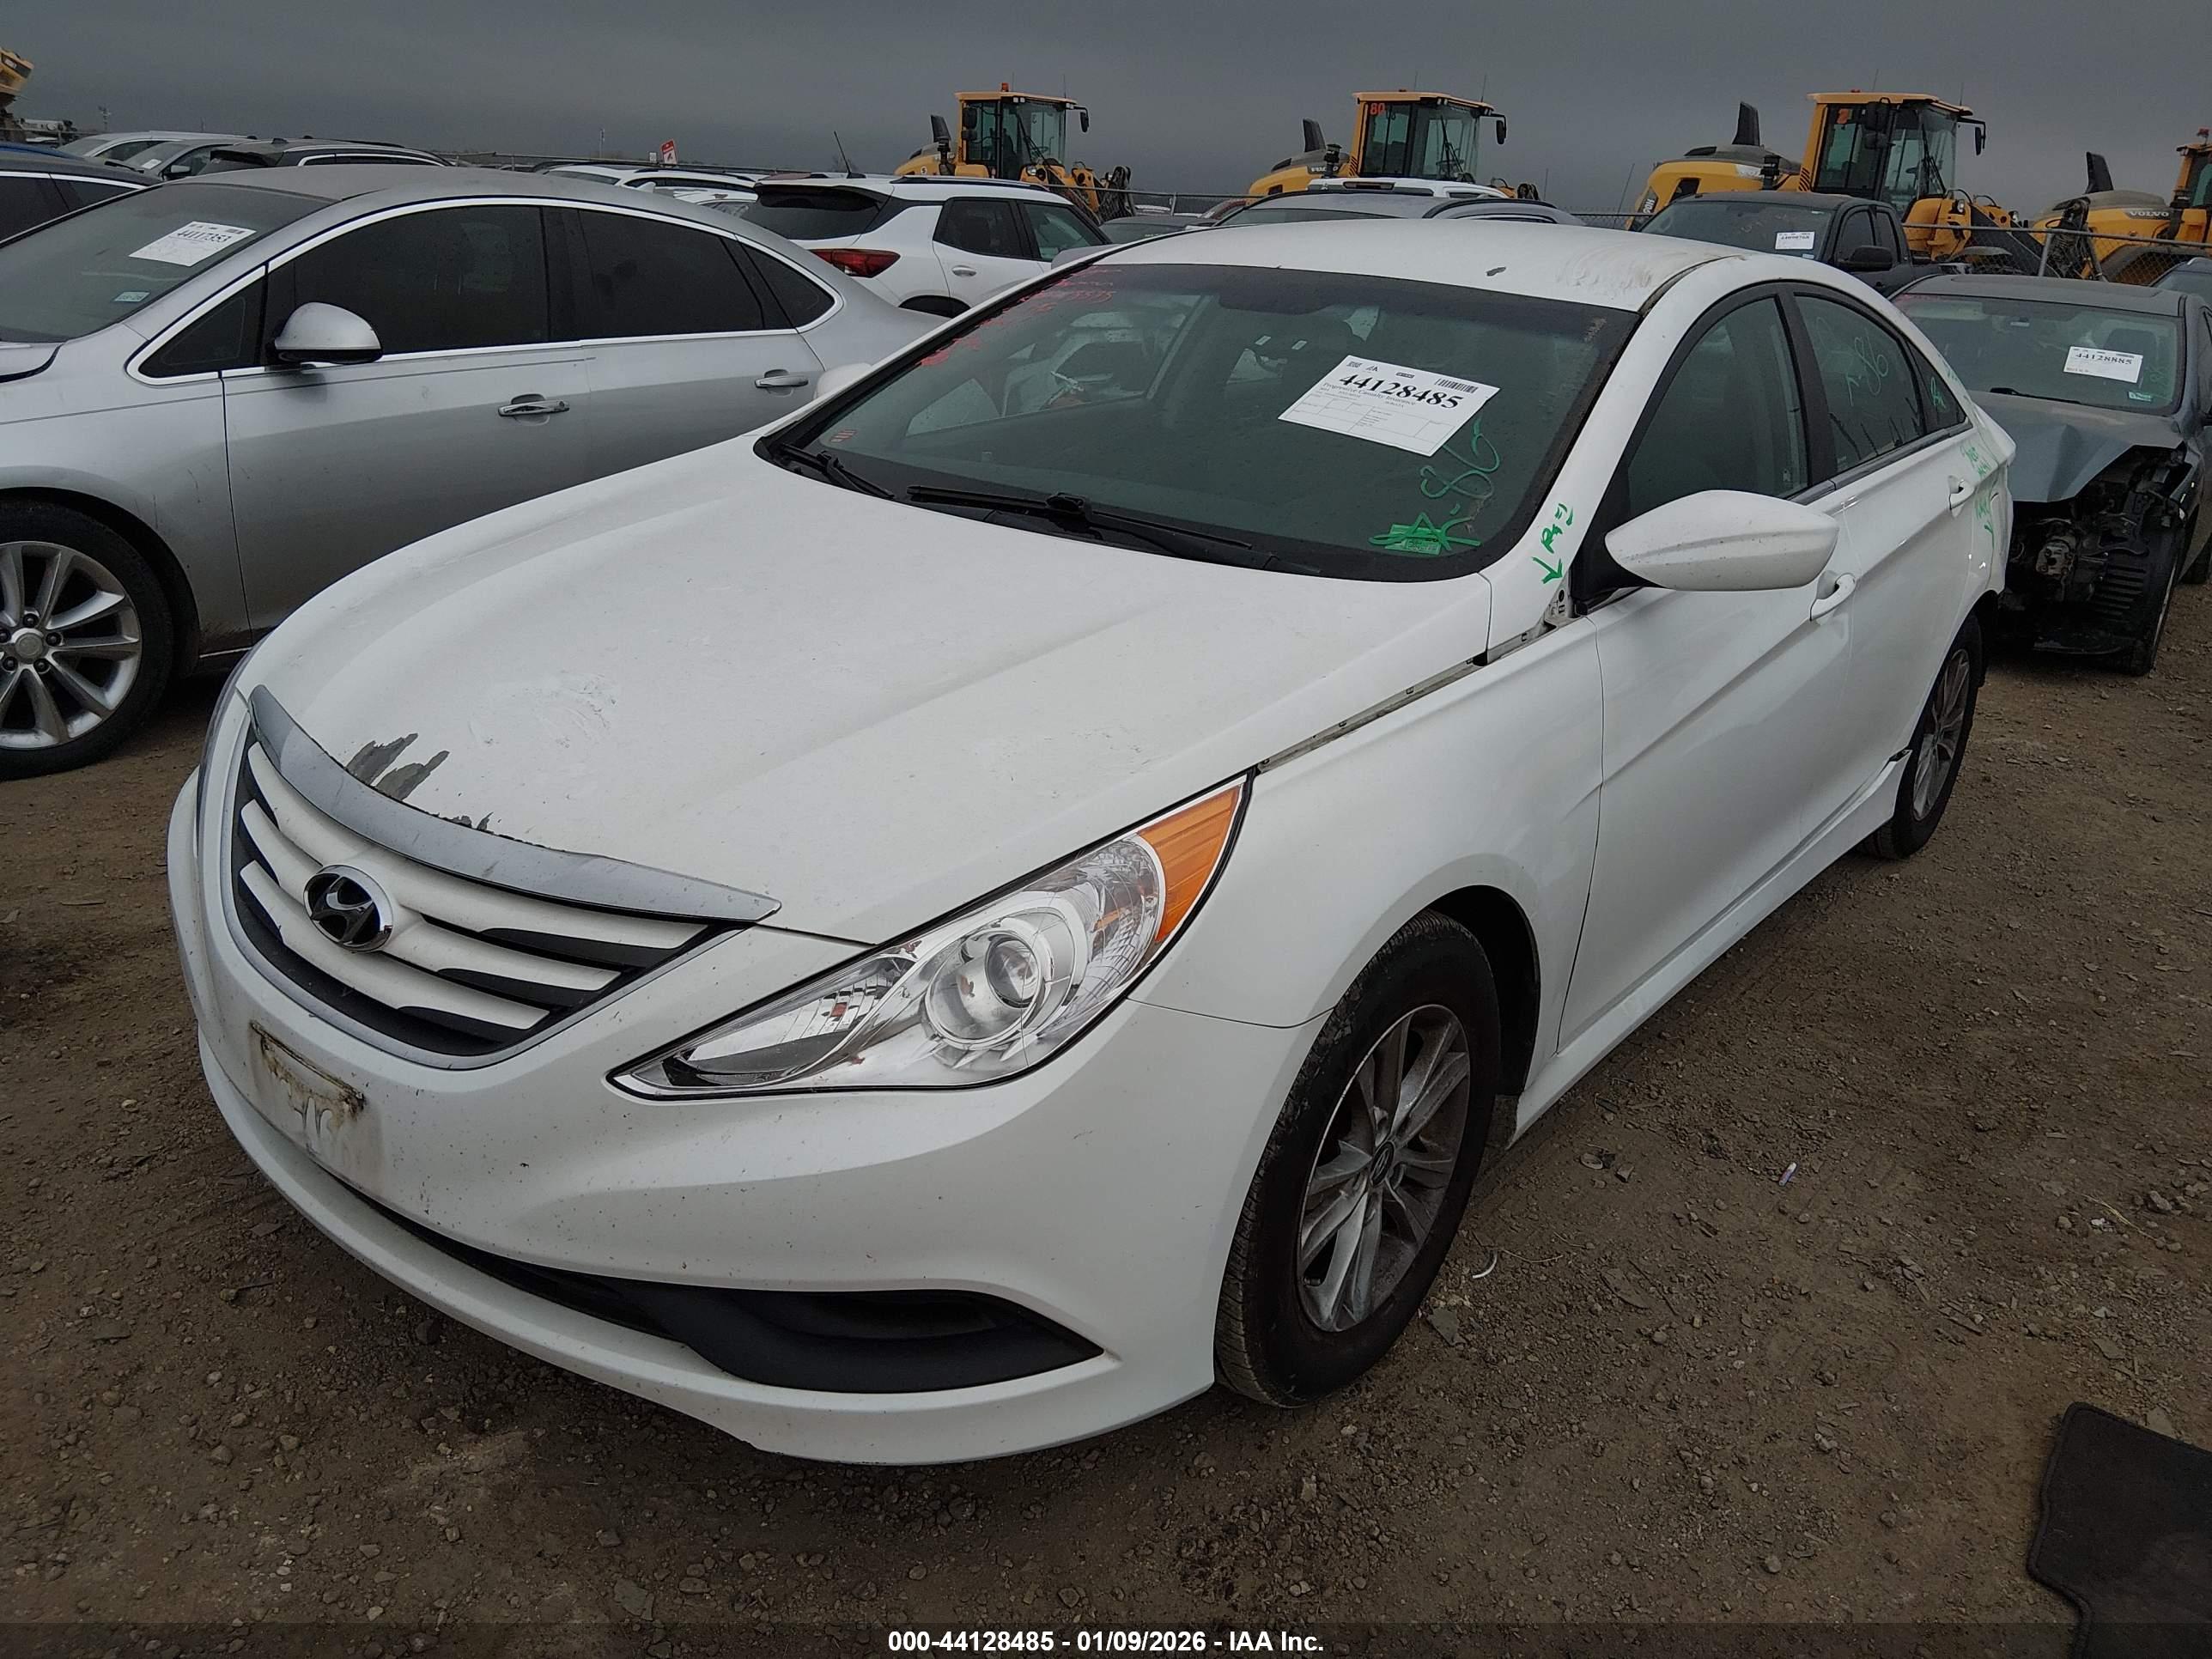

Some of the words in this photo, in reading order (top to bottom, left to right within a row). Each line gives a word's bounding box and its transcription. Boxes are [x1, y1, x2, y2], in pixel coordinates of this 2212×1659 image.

[1370, 102, 1386, 116] 80
[2075, 352, 2132, 365] 44128885
[1339, 374, 1463, 409] 44128485
